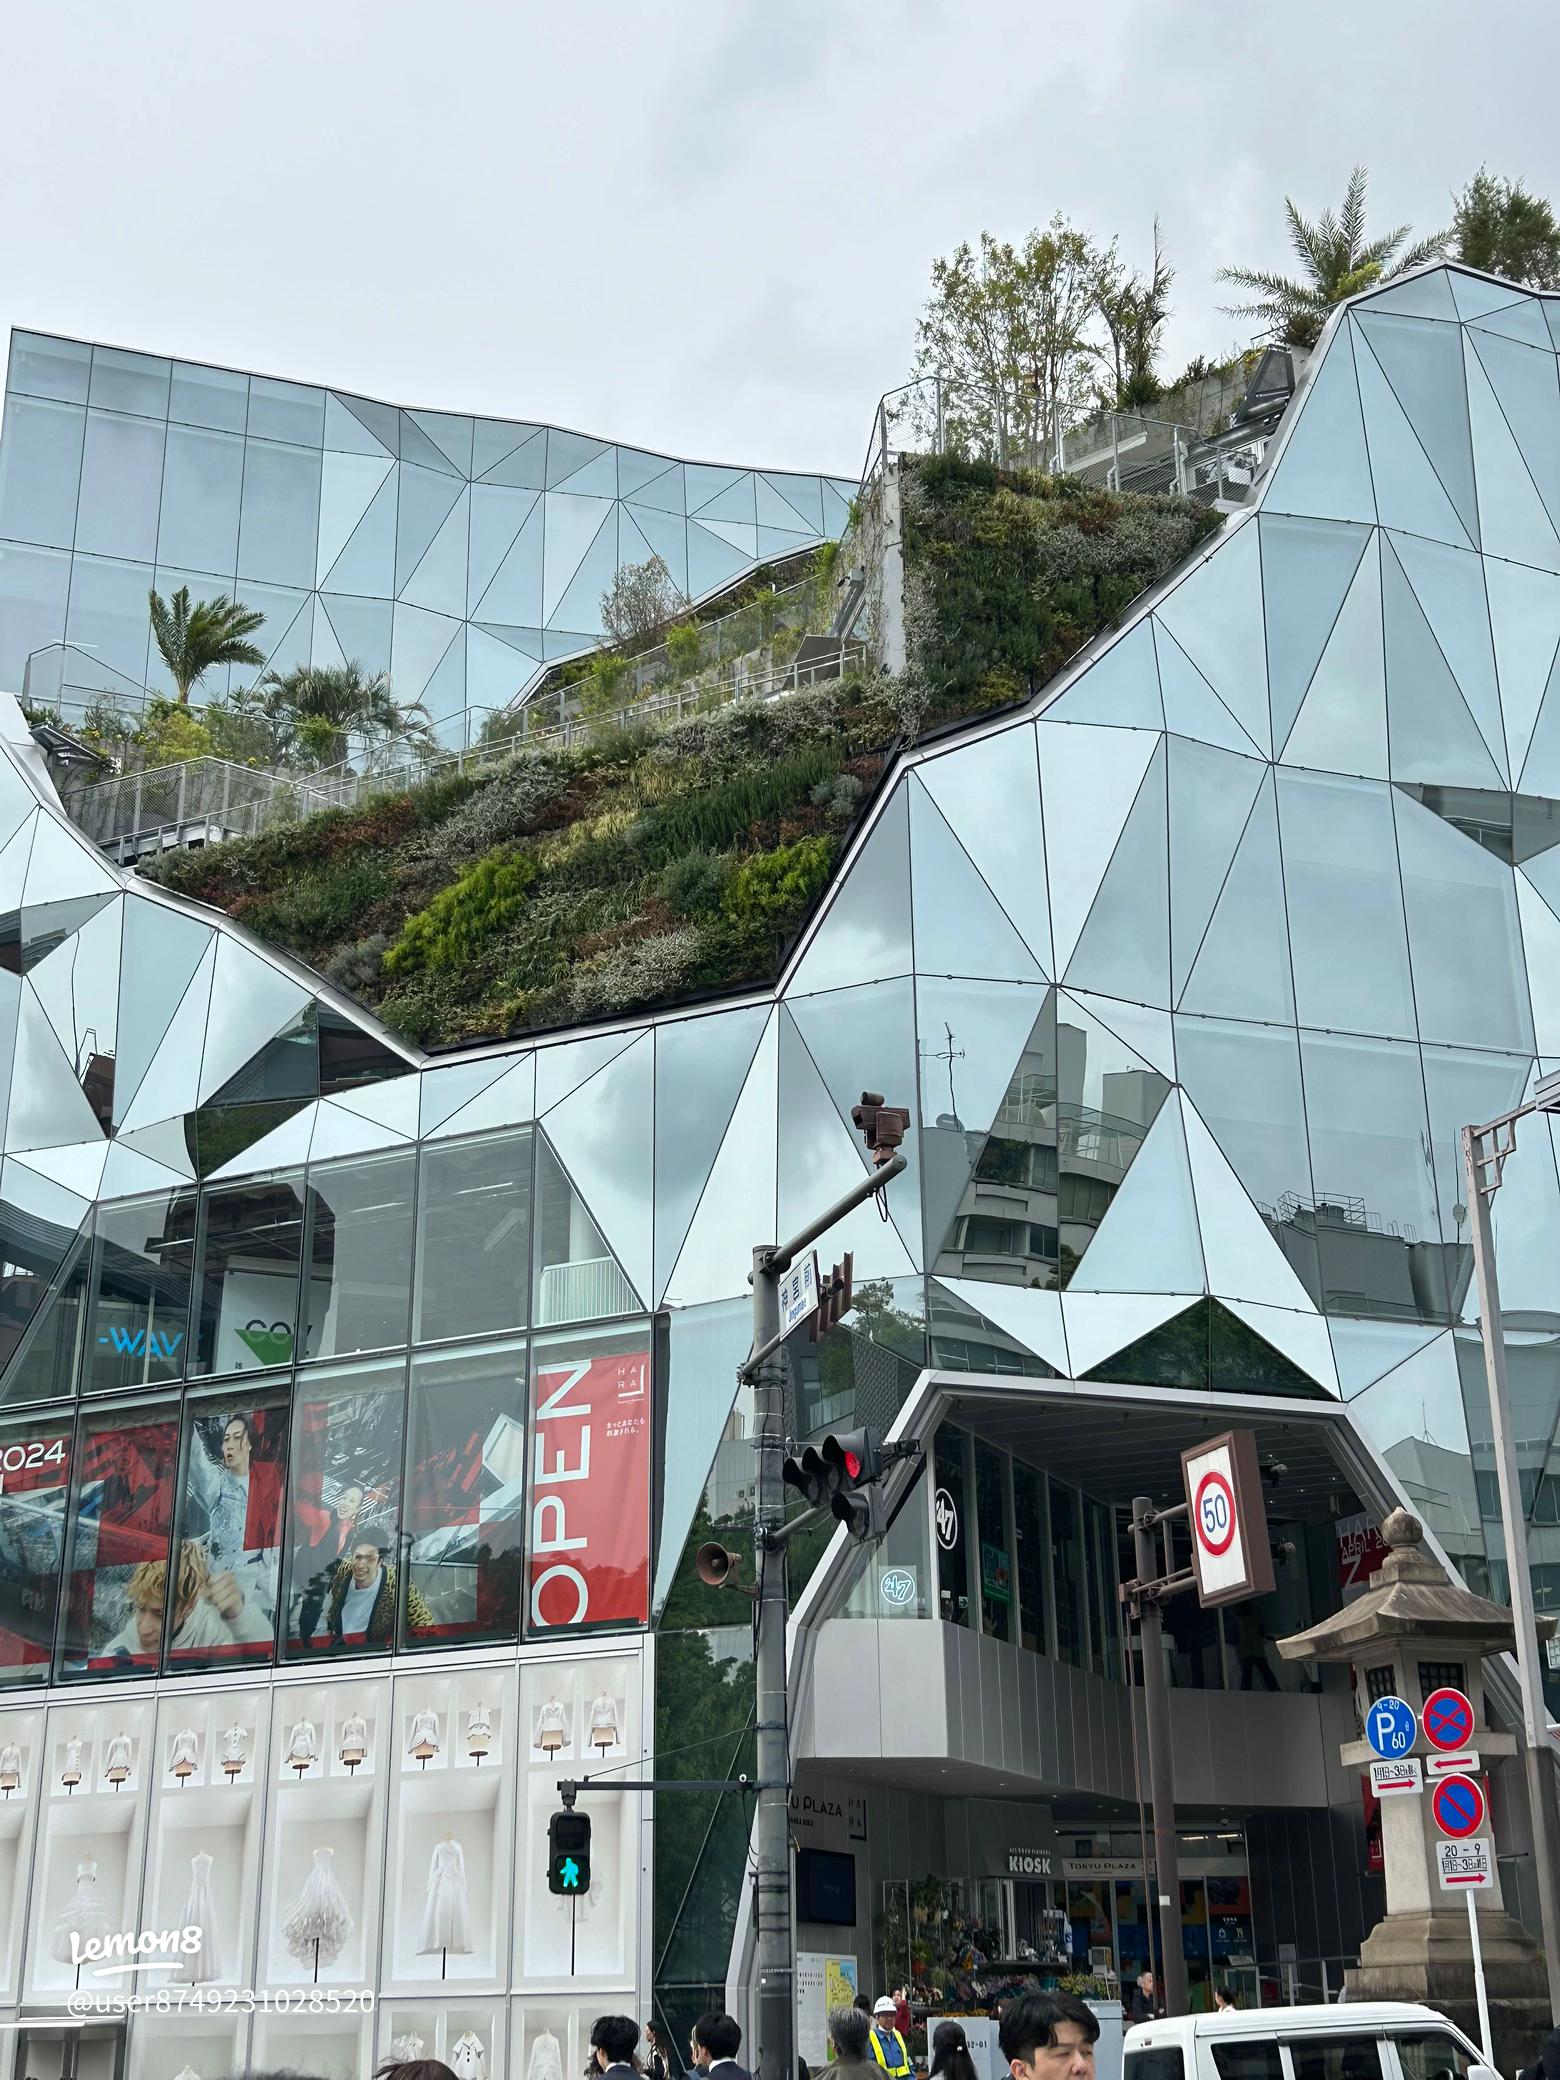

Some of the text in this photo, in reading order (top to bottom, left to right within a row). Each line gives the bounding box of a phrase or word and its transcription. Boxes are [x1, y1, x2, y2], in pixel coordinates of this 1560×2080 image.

[0, 1440, 66, 1472] 024
[531, 1358, 592, 1627] OPEN
[1203, 1494, 1227, 1533] 50
[1376, 1712, 1396, 1751] P
[803, 1795, 843, 1817] PLAZA
[1008, 1855, 1051, 1875] KIOSK
